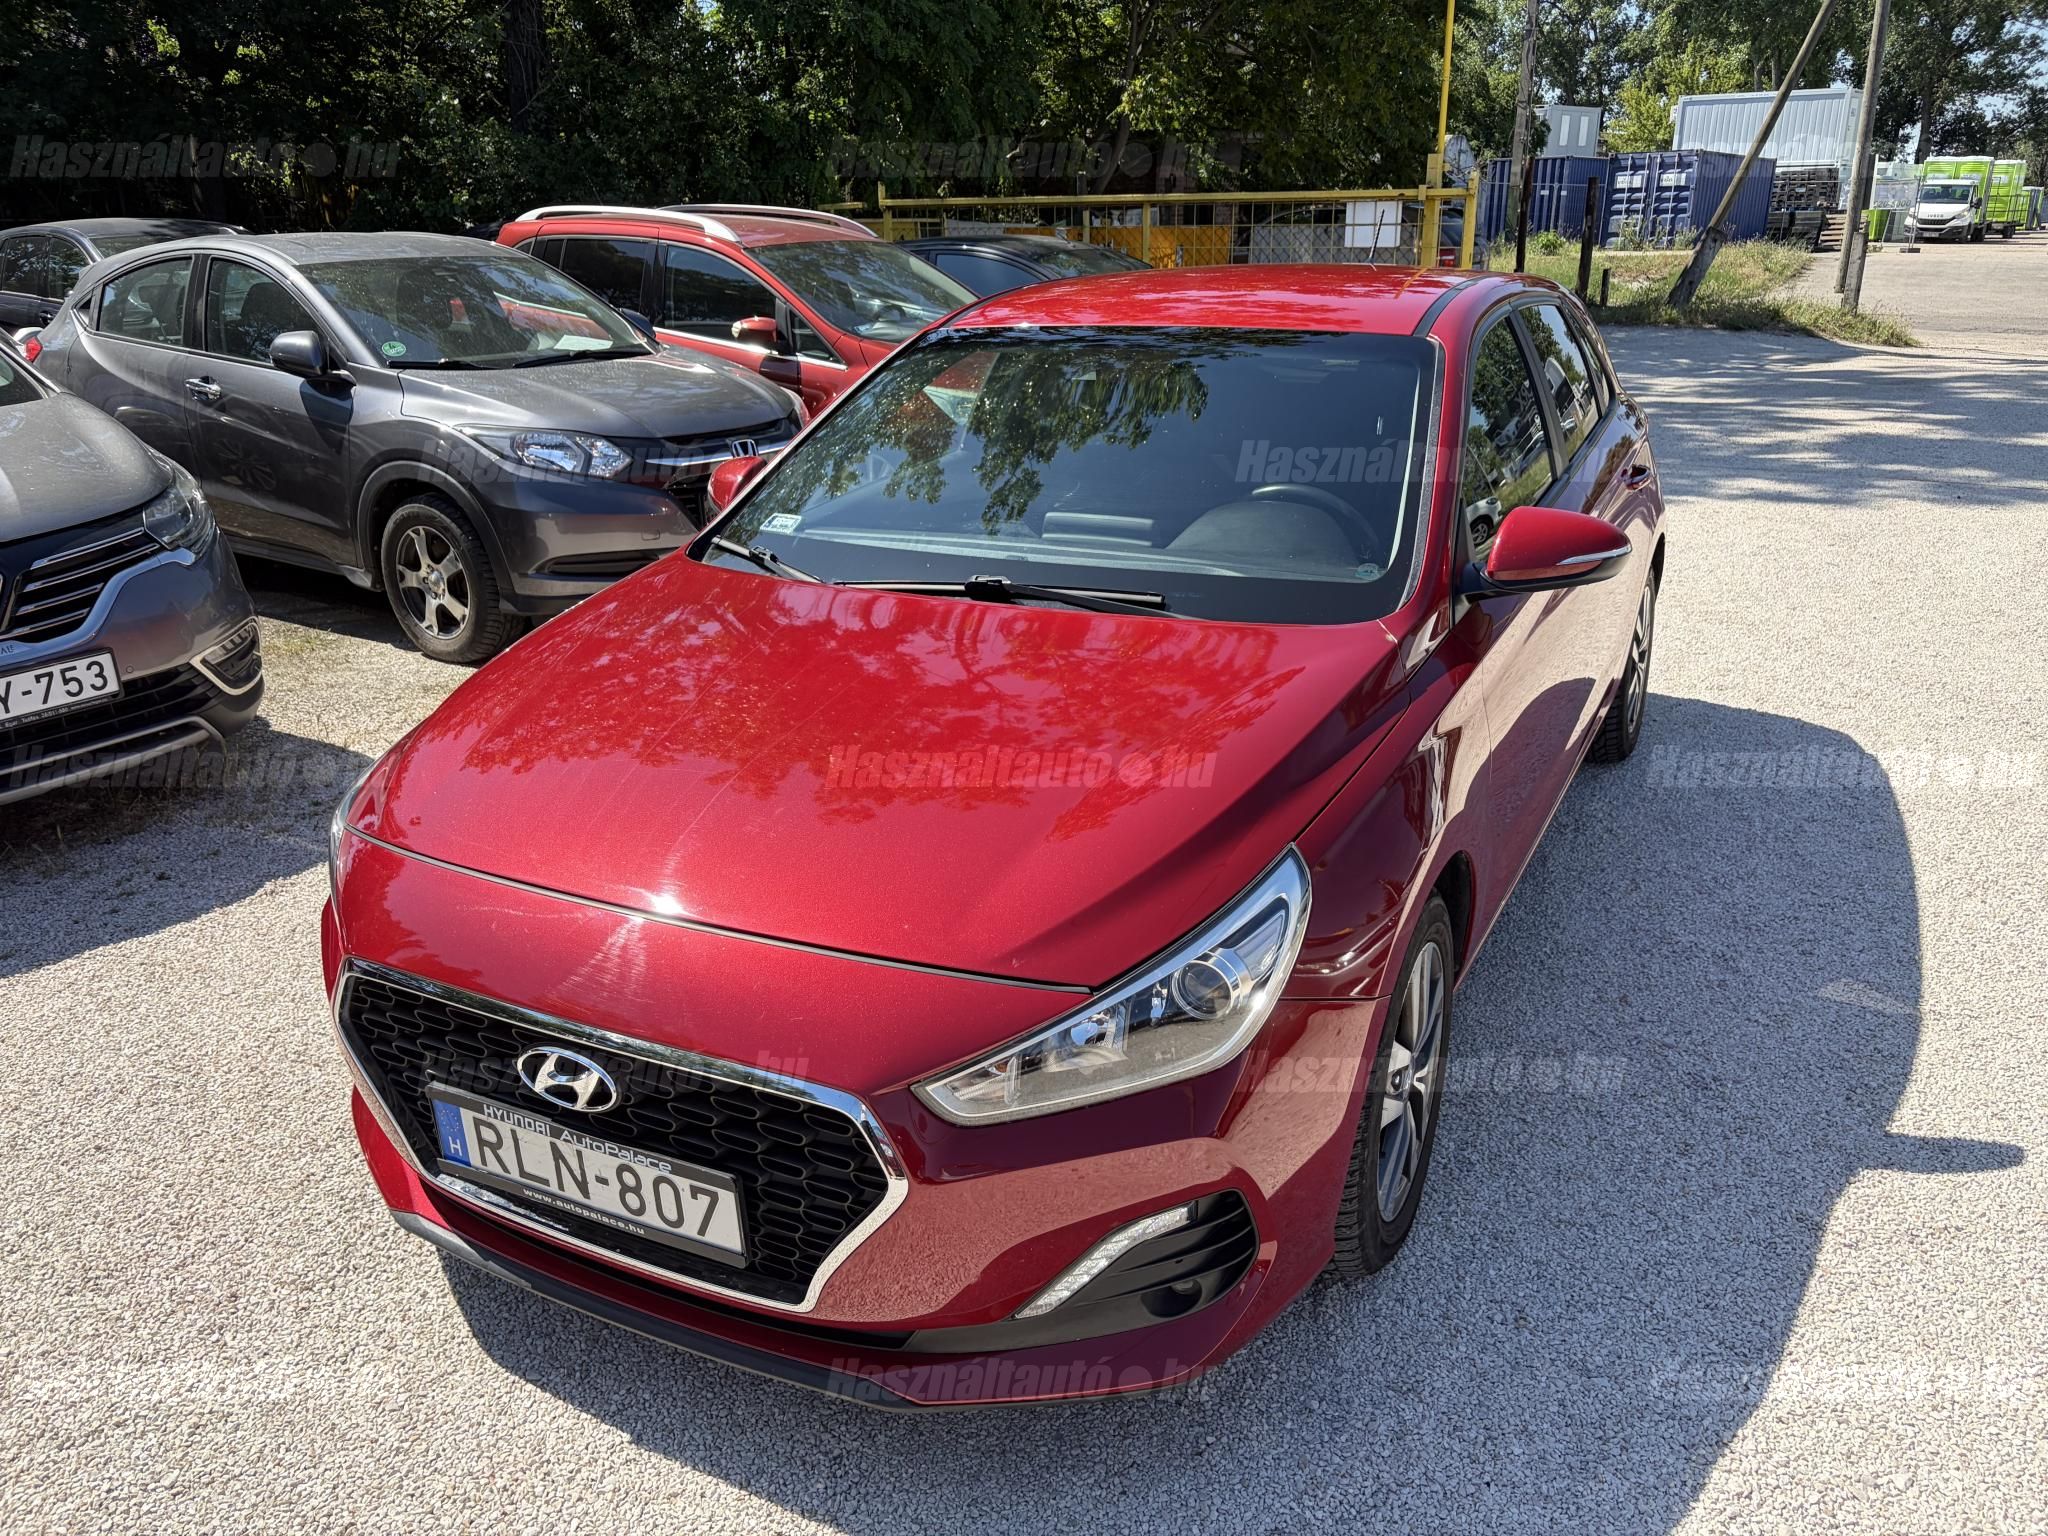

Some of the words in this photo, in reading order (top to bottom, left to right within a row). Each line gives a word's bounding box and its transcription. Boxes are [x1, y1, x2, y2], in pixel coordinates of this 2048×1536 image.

[448, 1136, 463, 1157] H
[484, 1104, 550, 1137] HYUNDAI
[560, 1130, 672, 1174] AutoPalace
[472, 1115, 720, 1238] RLN-807
[523, 1188, 645, 1235] www.autopalace.hu
